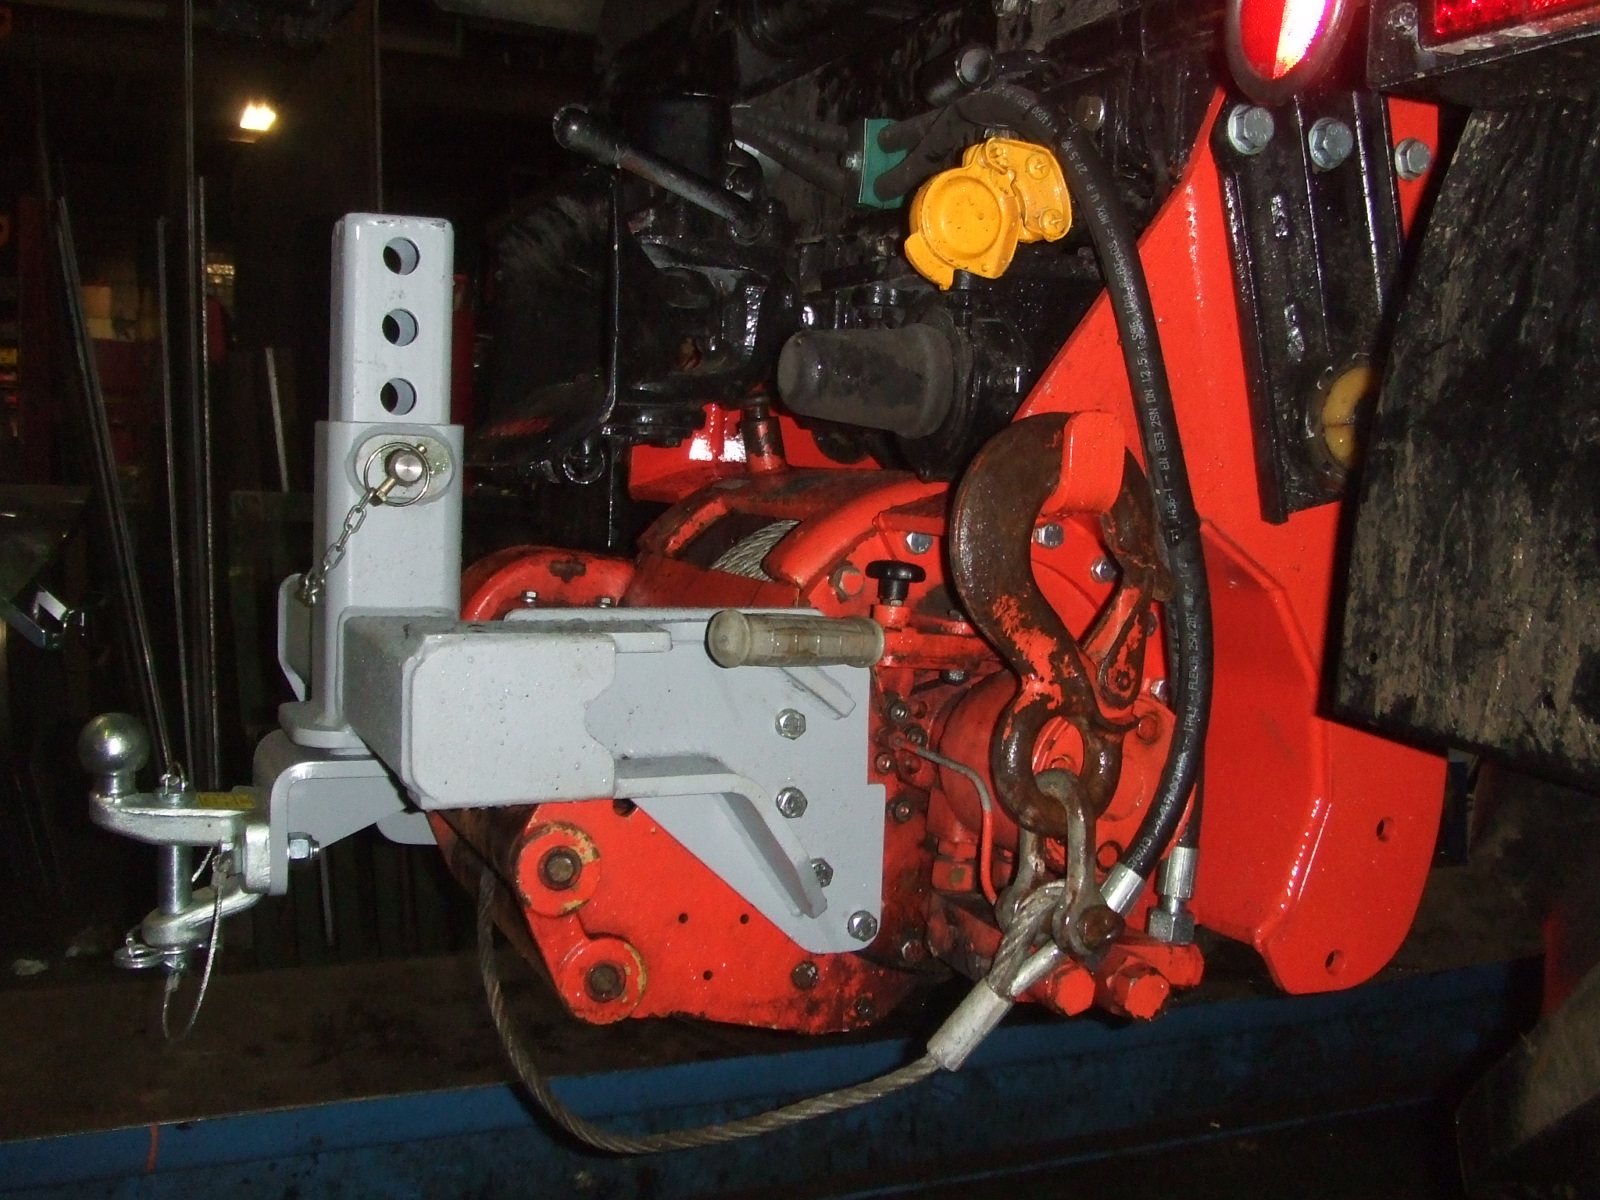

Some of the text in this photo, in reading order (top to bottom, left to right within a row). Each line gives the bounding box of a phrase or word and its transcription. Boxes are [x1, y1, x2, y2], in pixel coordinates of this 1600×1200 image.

[1143, 389, 1157, 403] DN
[1148, 408, 1162, 427] 2SN
[1154, 432, 1167, 452] 853
[1158, 457, 1170, 471] EN
